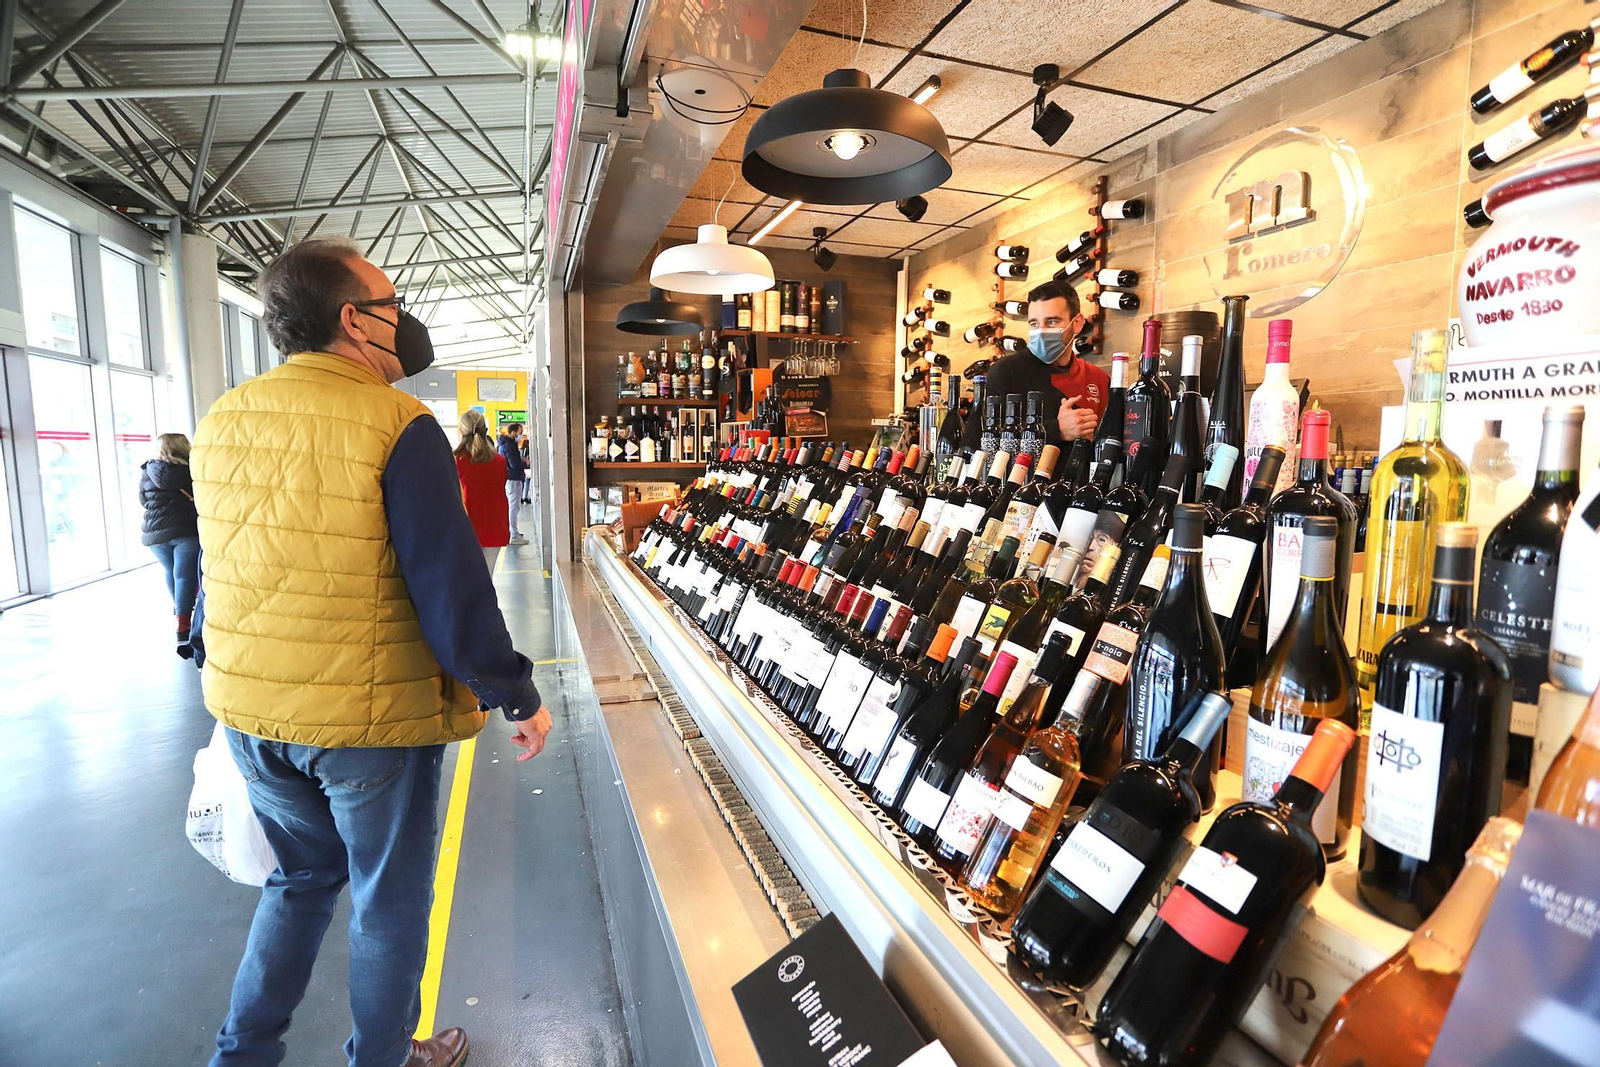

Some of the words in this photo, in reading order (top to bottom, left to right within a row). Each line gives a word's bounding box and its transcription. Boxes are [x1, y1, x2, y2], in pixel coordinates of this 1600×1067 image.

[1224, 170, 1316, 244] m
[1223, 242, 1332, 280] romero
[1467, 235, 1581, 278] VERMOUTH
[1466, 264, 1576, 302] NAVARRO
[1476, 308, 1514, 325] Desde
[1447, 367, 1514, 384] RMUTH
[1522, 366, 1536, 379] A
[1464, 387, 1544, 401] MONTILLA
[1481, 608, 1552, 631] CELESTE
[1248, 727, 1305, 757] mestizaje
